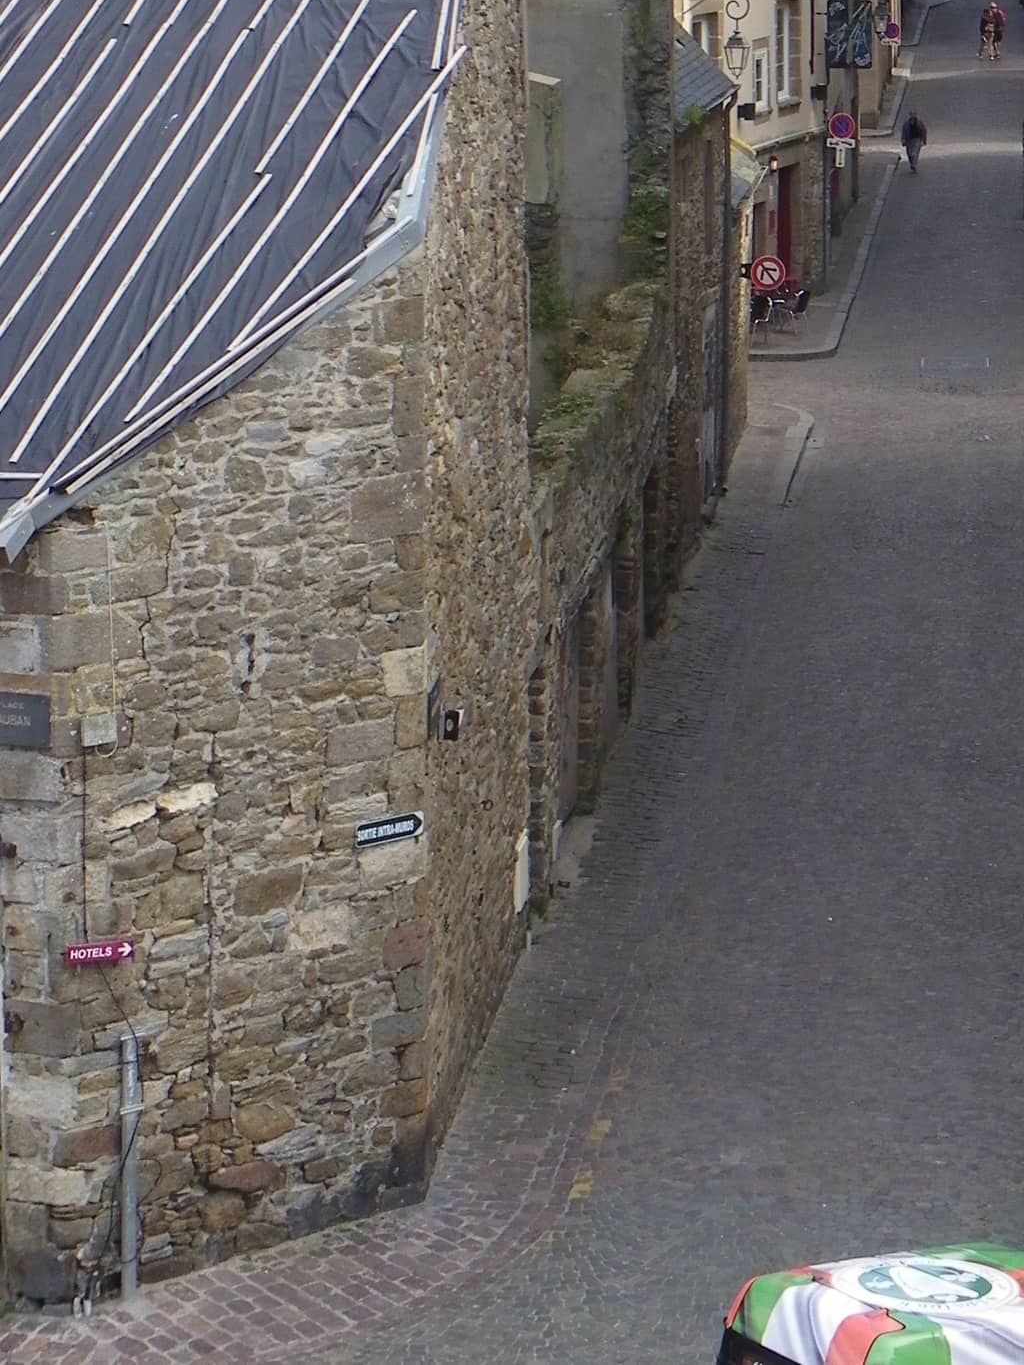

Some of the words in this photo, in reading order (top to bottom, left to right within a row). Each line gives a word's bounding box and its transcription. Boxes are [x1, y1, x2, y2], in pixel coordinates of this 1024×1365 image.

[358, 828, 377, 841] SORTIE
[378, 820, 414, 837] INTRA-MUROS
[70, 946, 113, 960] HOTELS
